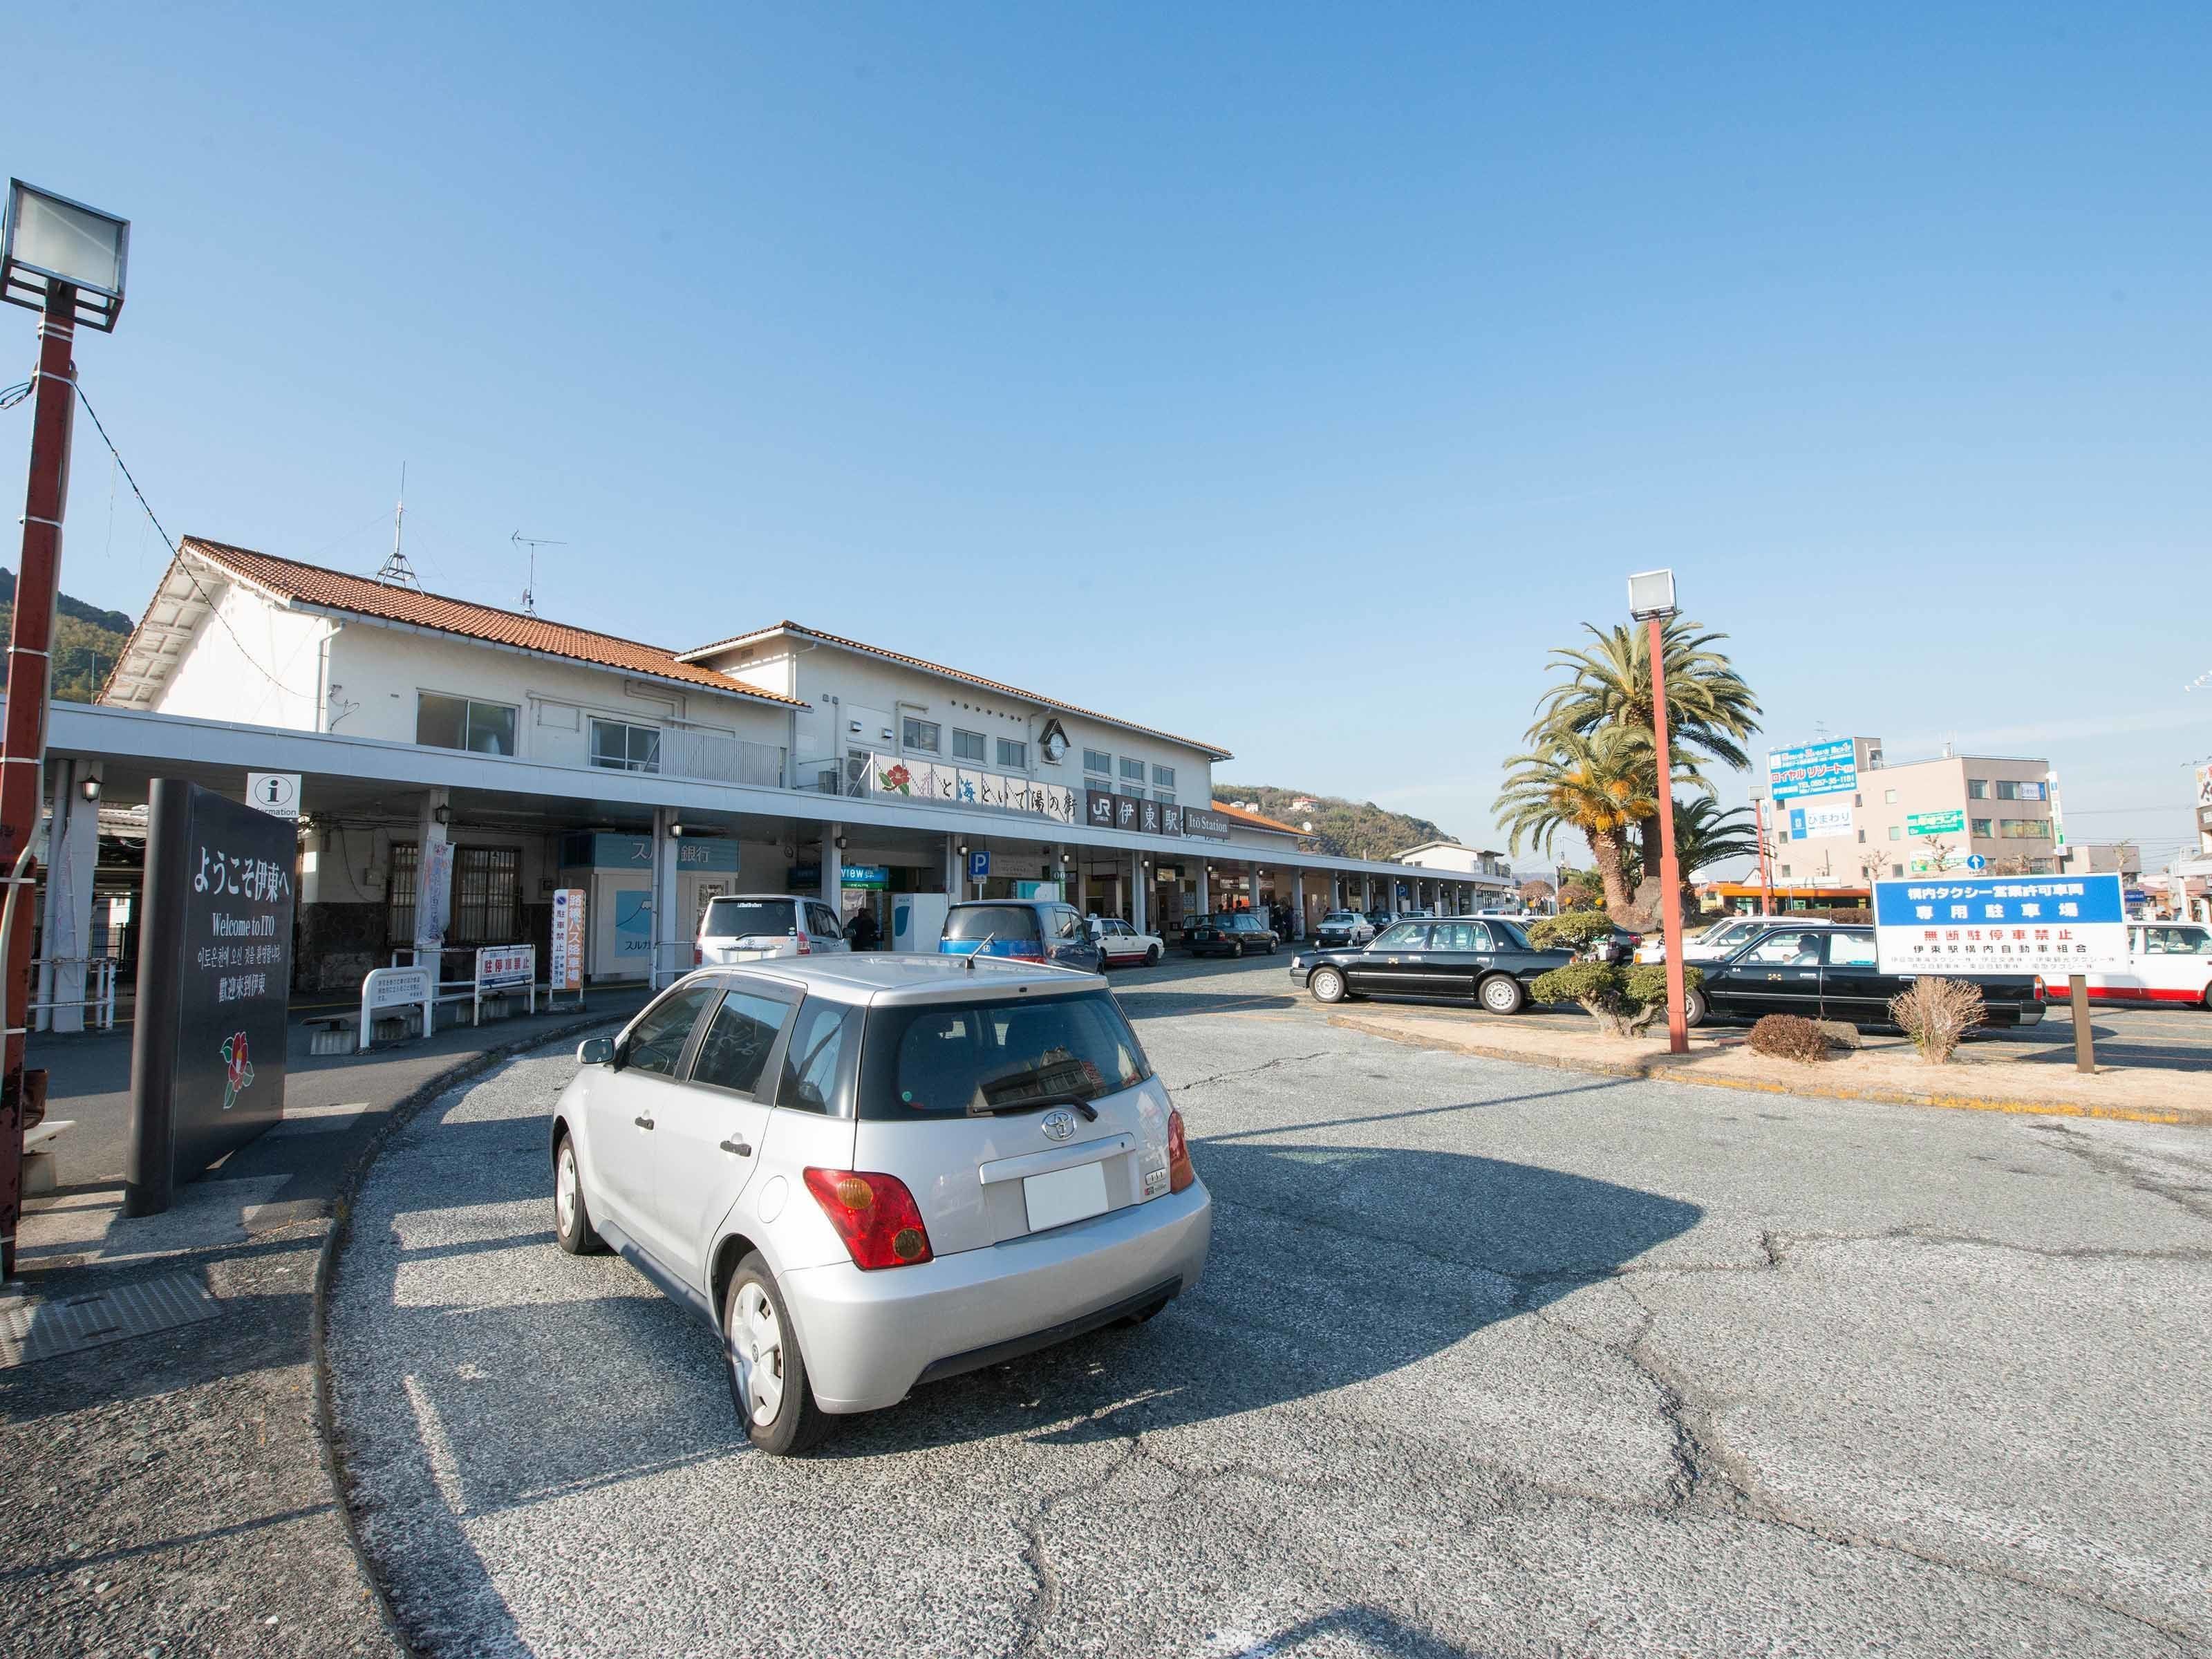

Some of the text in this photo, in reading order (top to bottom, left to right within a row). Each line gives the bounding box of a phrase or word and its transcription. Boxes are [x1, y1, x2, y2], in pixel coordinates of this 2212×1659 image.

[1093, 798, 1111, 816] JR
[1119, 801, 1178, 831] 伊東駅
[1201, 816, 1228, 833] Station
[1808, 812, 1849, 825] ひまわり
[631, 842, 710, 863] ス銀行
[975, 854, 986, 873] P
[194, 846, 290, 903] ようこそ伊東へ
[212, 912, 275, 937] Welcome to ITO
[556, 910, 564, 952] 駐車禁止
[1924, 929, 2073, 941] 無断駐停車禁止
[1913, 944, 2087, 954] 伊東駅構内自動車組合
[485, 957, 530, 974] 駐停車禁止
